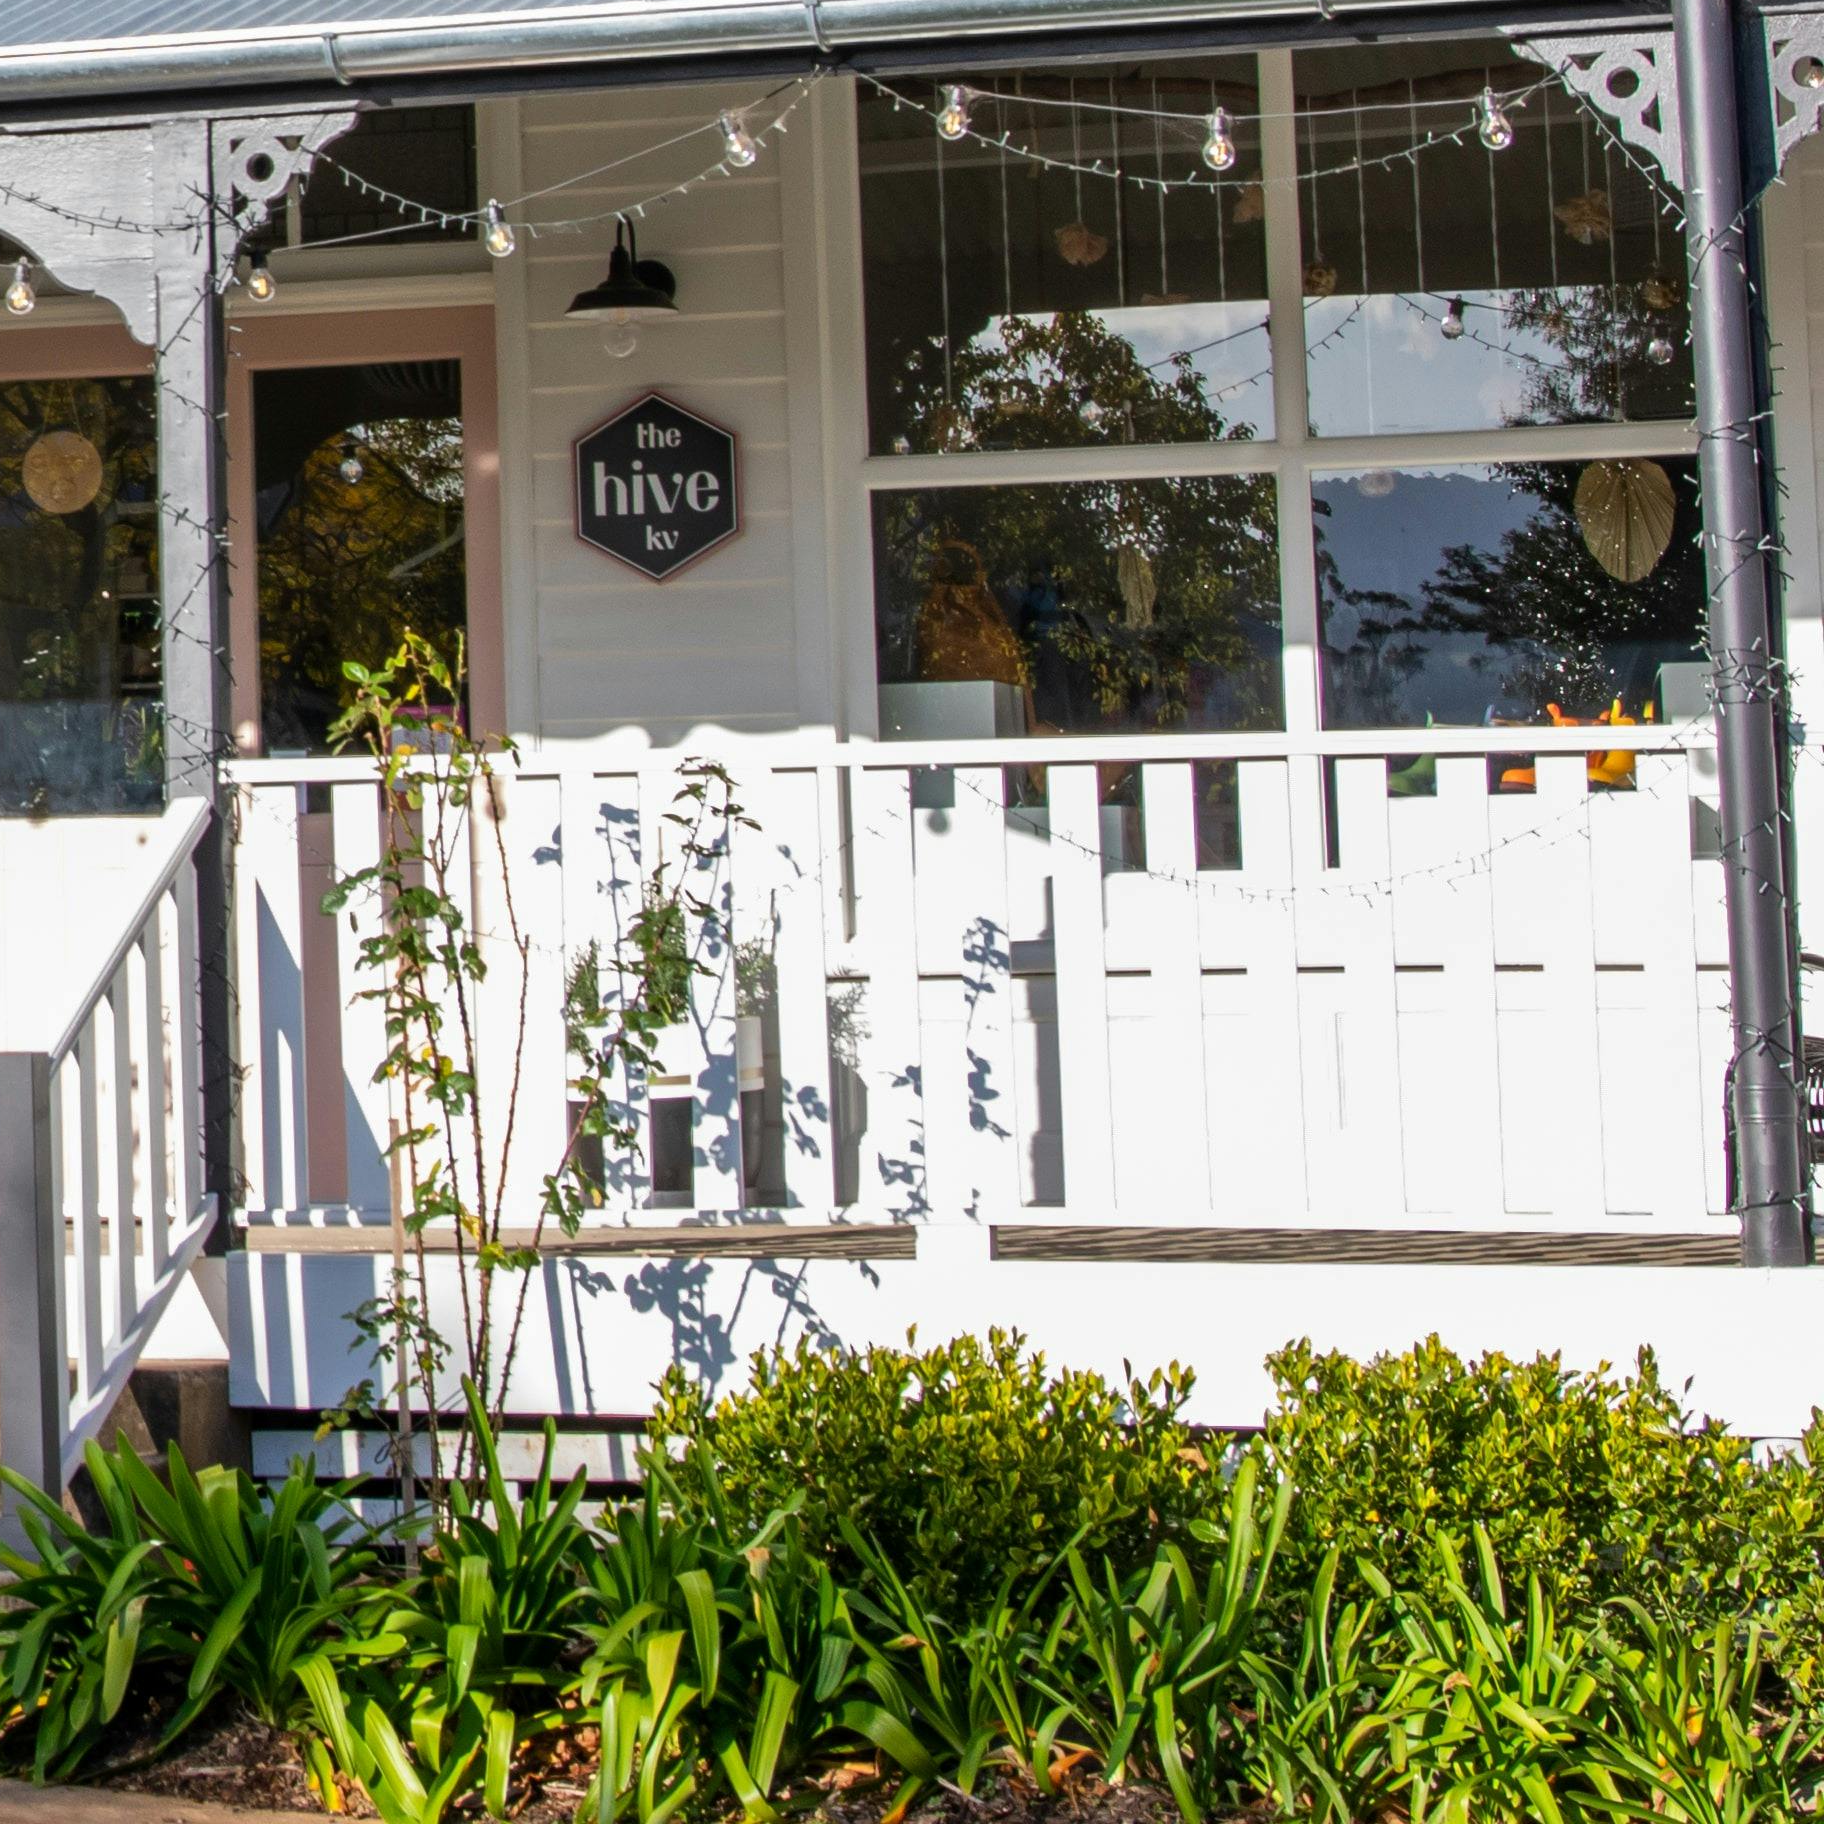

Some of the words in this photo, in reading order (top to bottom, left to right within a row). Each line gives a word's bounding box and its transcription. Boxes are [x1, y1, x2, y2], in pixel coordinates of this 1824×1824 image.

[636, 423, 683, 449] the
[593, 460, 720, 517] hive
[646, 525, 680, 551] kv
